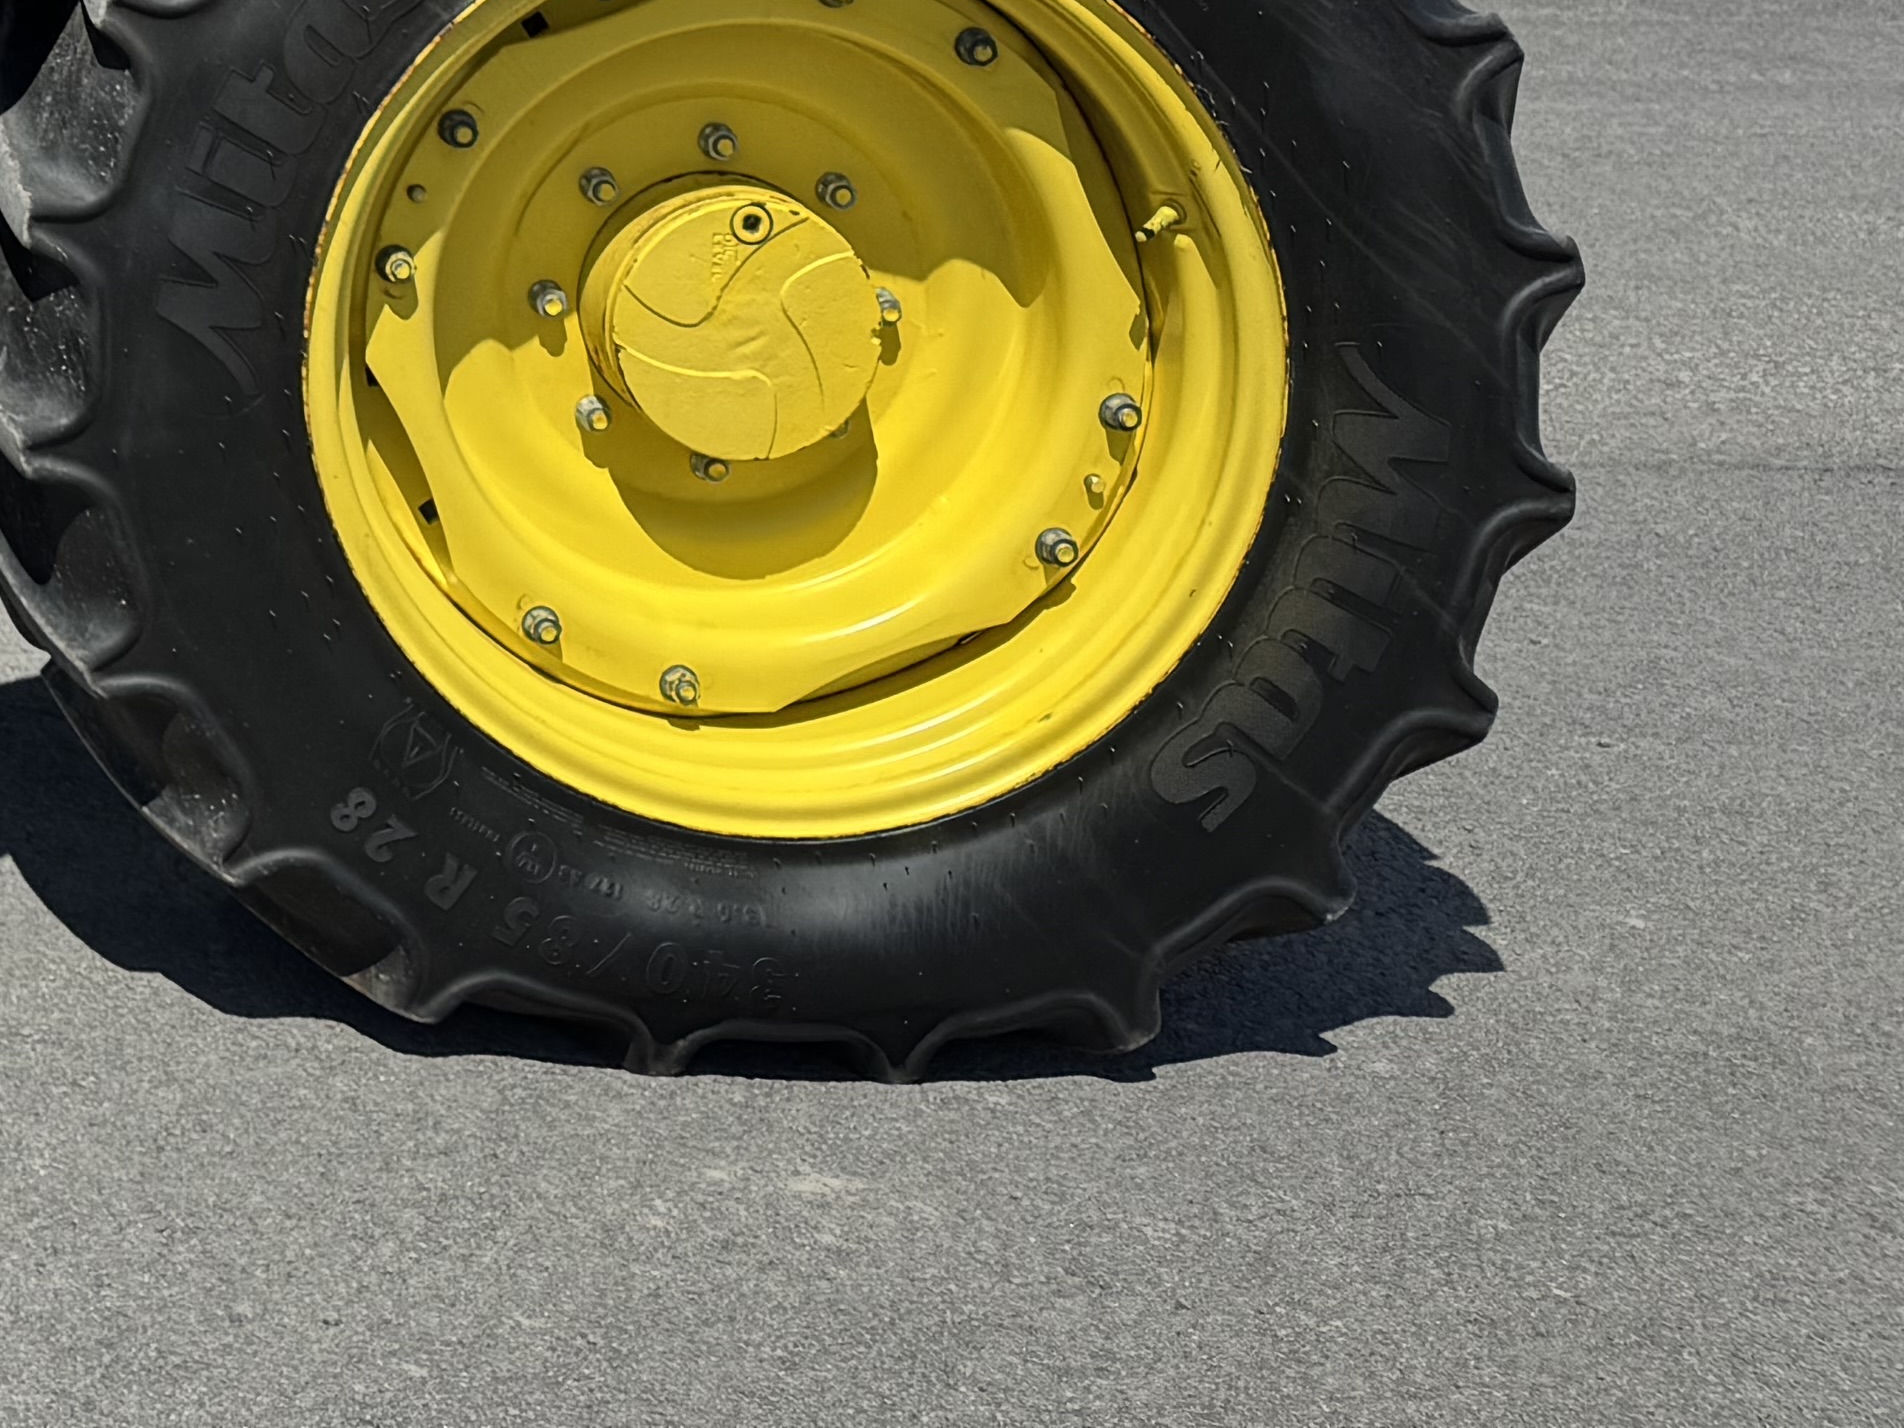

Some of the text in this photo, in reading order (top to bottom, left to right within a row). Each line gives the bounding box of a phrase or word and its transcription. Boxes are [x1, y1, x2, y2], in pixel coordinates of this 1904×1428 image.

[1147, 338, 1453, 835] Mitas
[329, 785, 420, 865] 28
[422, 852, 478, 912] R
